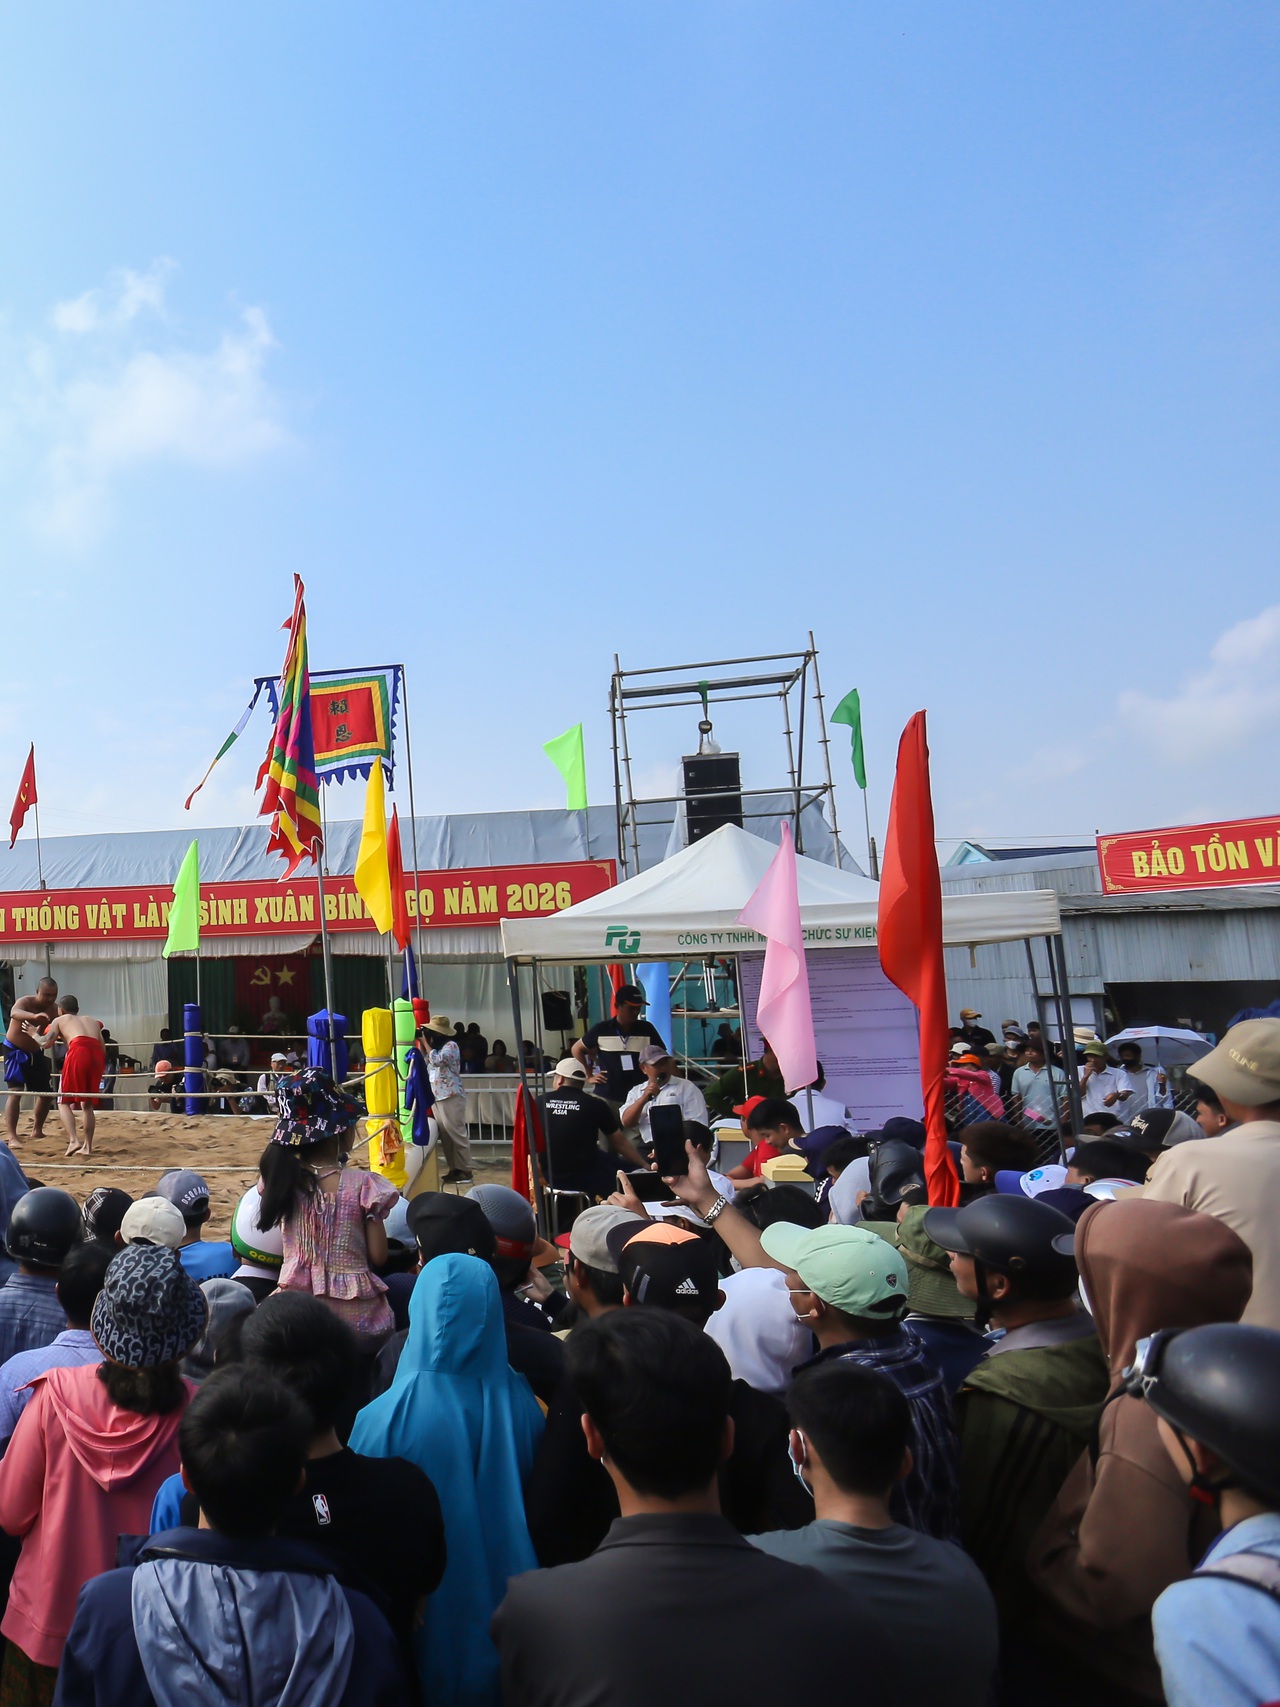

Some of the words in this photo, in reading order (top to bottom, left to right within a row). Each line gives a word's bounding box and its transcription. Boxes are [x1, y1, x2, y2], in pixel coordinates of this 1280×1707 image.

[1131, 839, 1185, 878] BẢO
[1190, 833, 1250, 873] TỒN
[1253, 830, 1280, 868] V
[11, 896, 79, 932] THỐNG
[85, 898, 127, 935] VẬT
[133, 894, 173, 928] LÀN
[198, 893, 248, 926] SÌNH
[254, 889, 314, 924] XUÂN
[405, 888, 434, 923] GỌ
[443, 880, 499, 916] NĂM
[506, 881, 572, 912] 2026
[677, 931, 708, 945] CÔNG
[710, 932, 724, 944] TY
[725, 931, 755, 944] TNHH
[801, 926, 832, 941] CHỨC
[835, 927, 852, 942] SỰ
[545, 1102, 580, 1111] WRESTLING
[676, 1287, 699, 1295] adidas
